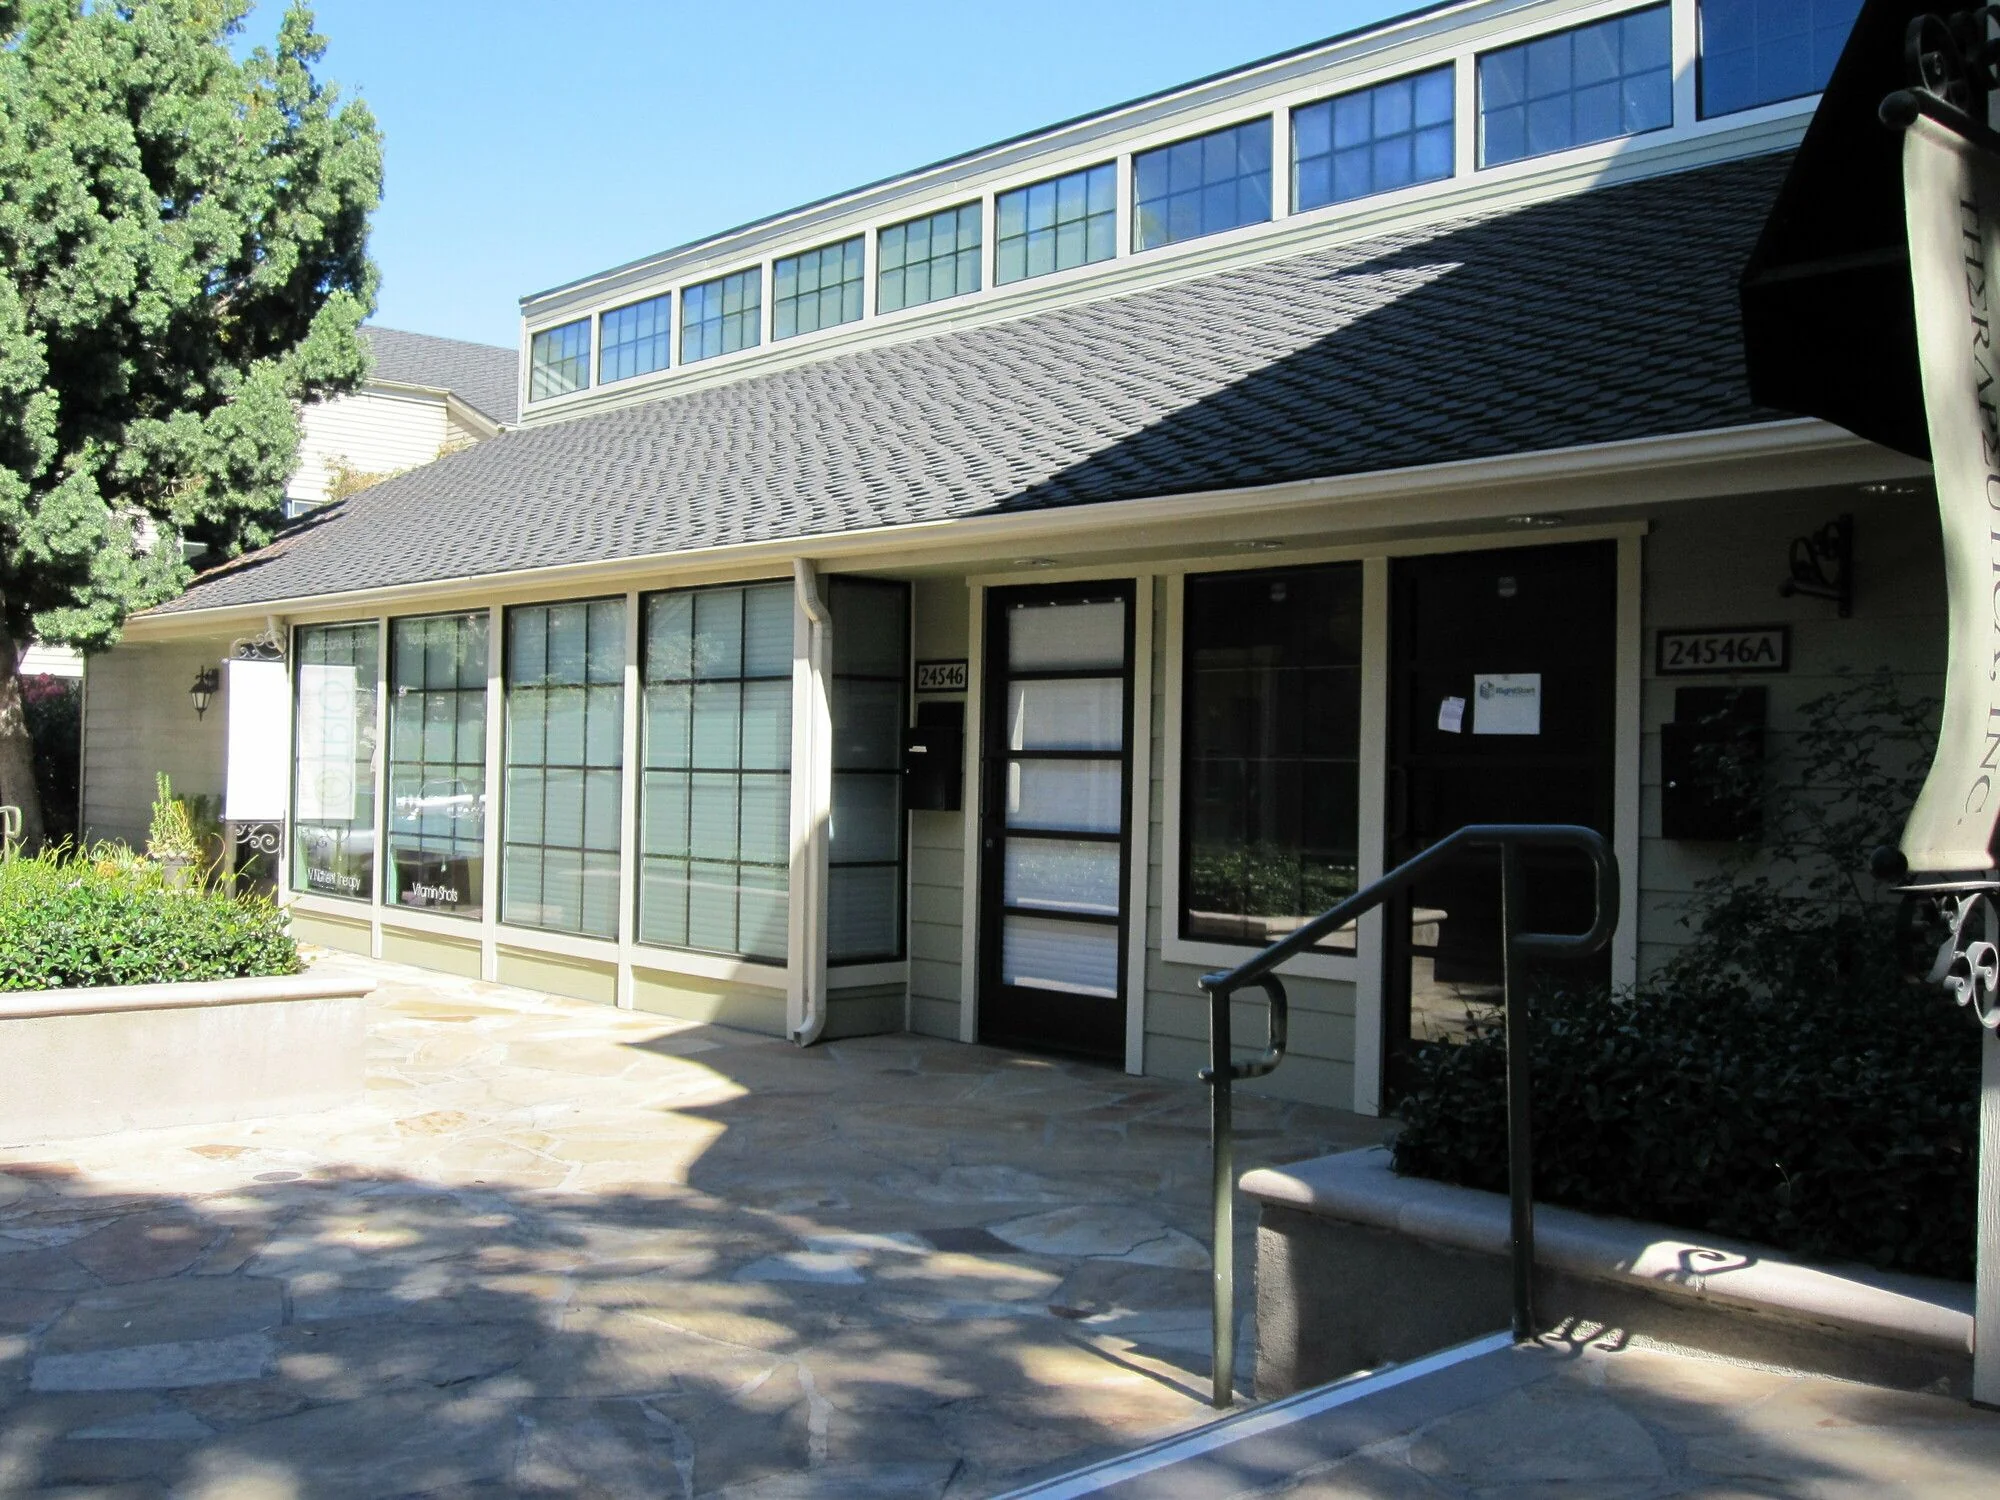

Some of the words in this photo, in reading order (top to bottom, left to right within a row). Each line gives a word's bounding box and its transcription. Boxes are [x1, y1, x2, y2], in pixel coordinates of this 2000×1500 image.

[1668, 636, 1777, 666] 24546A
[920, 665, 964, 687] 24546
[336, 872, 361, 891] Therapy
[412, 882, 438, 899] Vitamin
[438, 885, 458, 902] Shots
